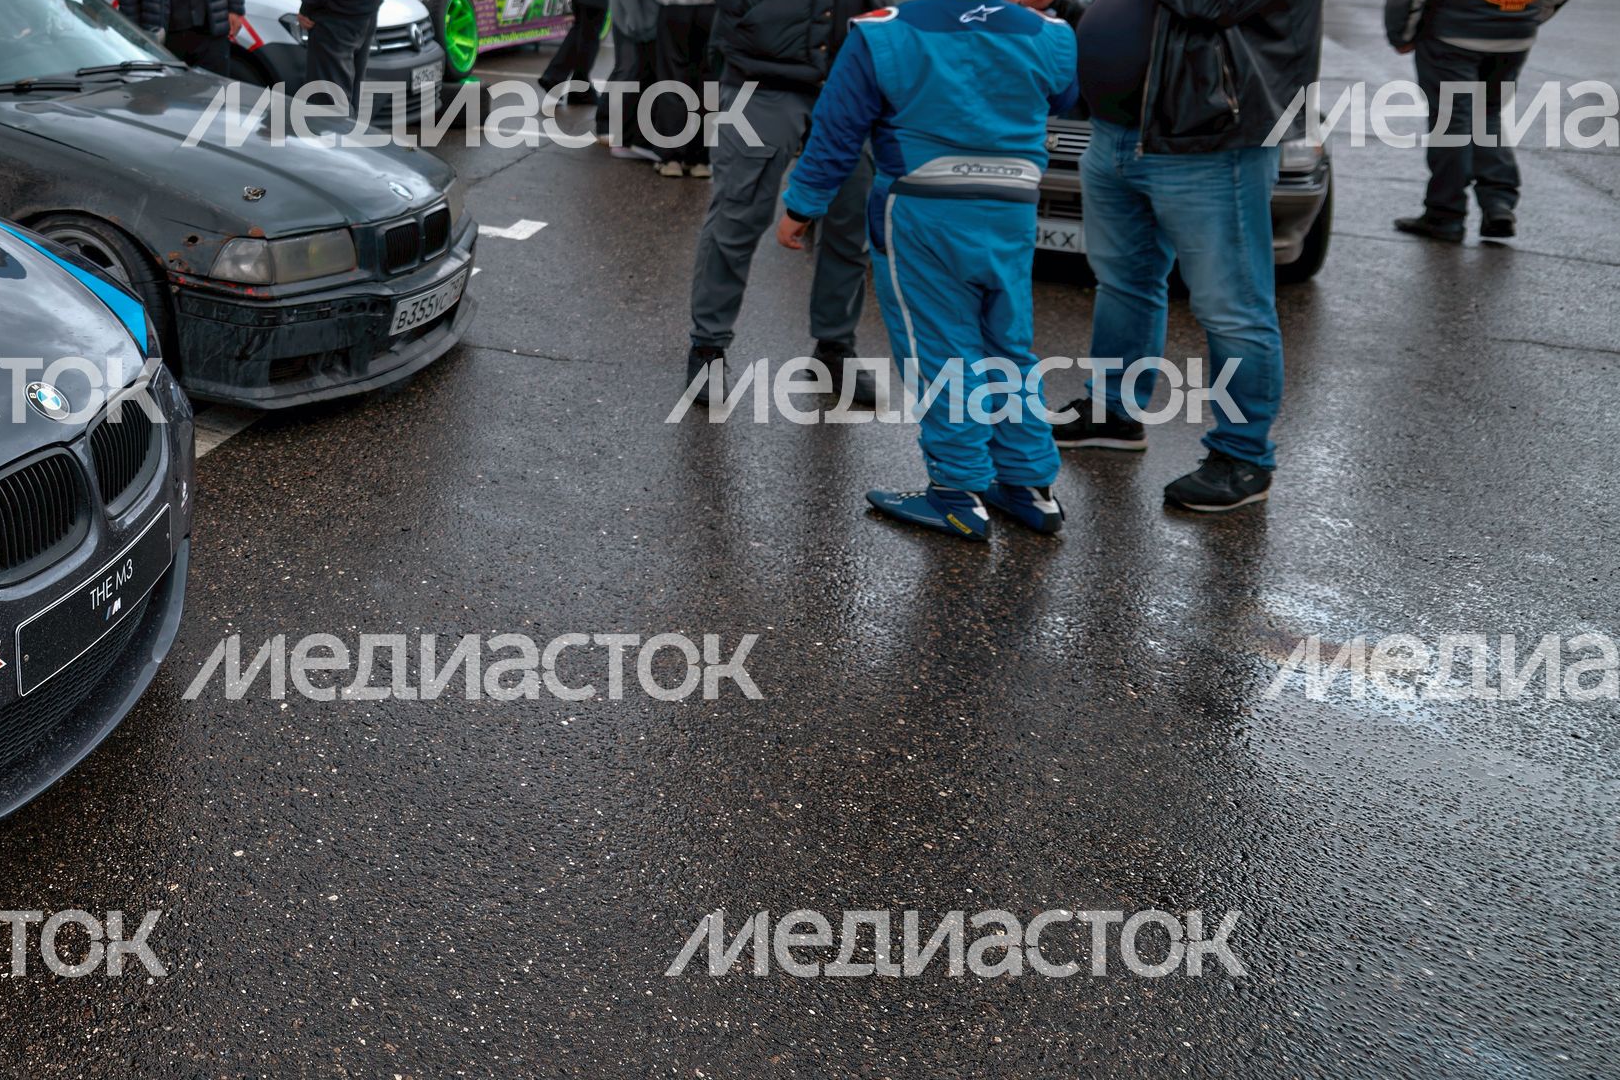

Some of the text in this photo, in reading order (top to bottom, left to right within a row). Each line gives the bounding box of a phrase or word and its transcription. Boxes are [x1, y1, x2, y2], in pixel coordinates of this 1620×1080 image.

[1036, 226, 1076, 248] КХ
[90, 558, 133, 610] THE M3
